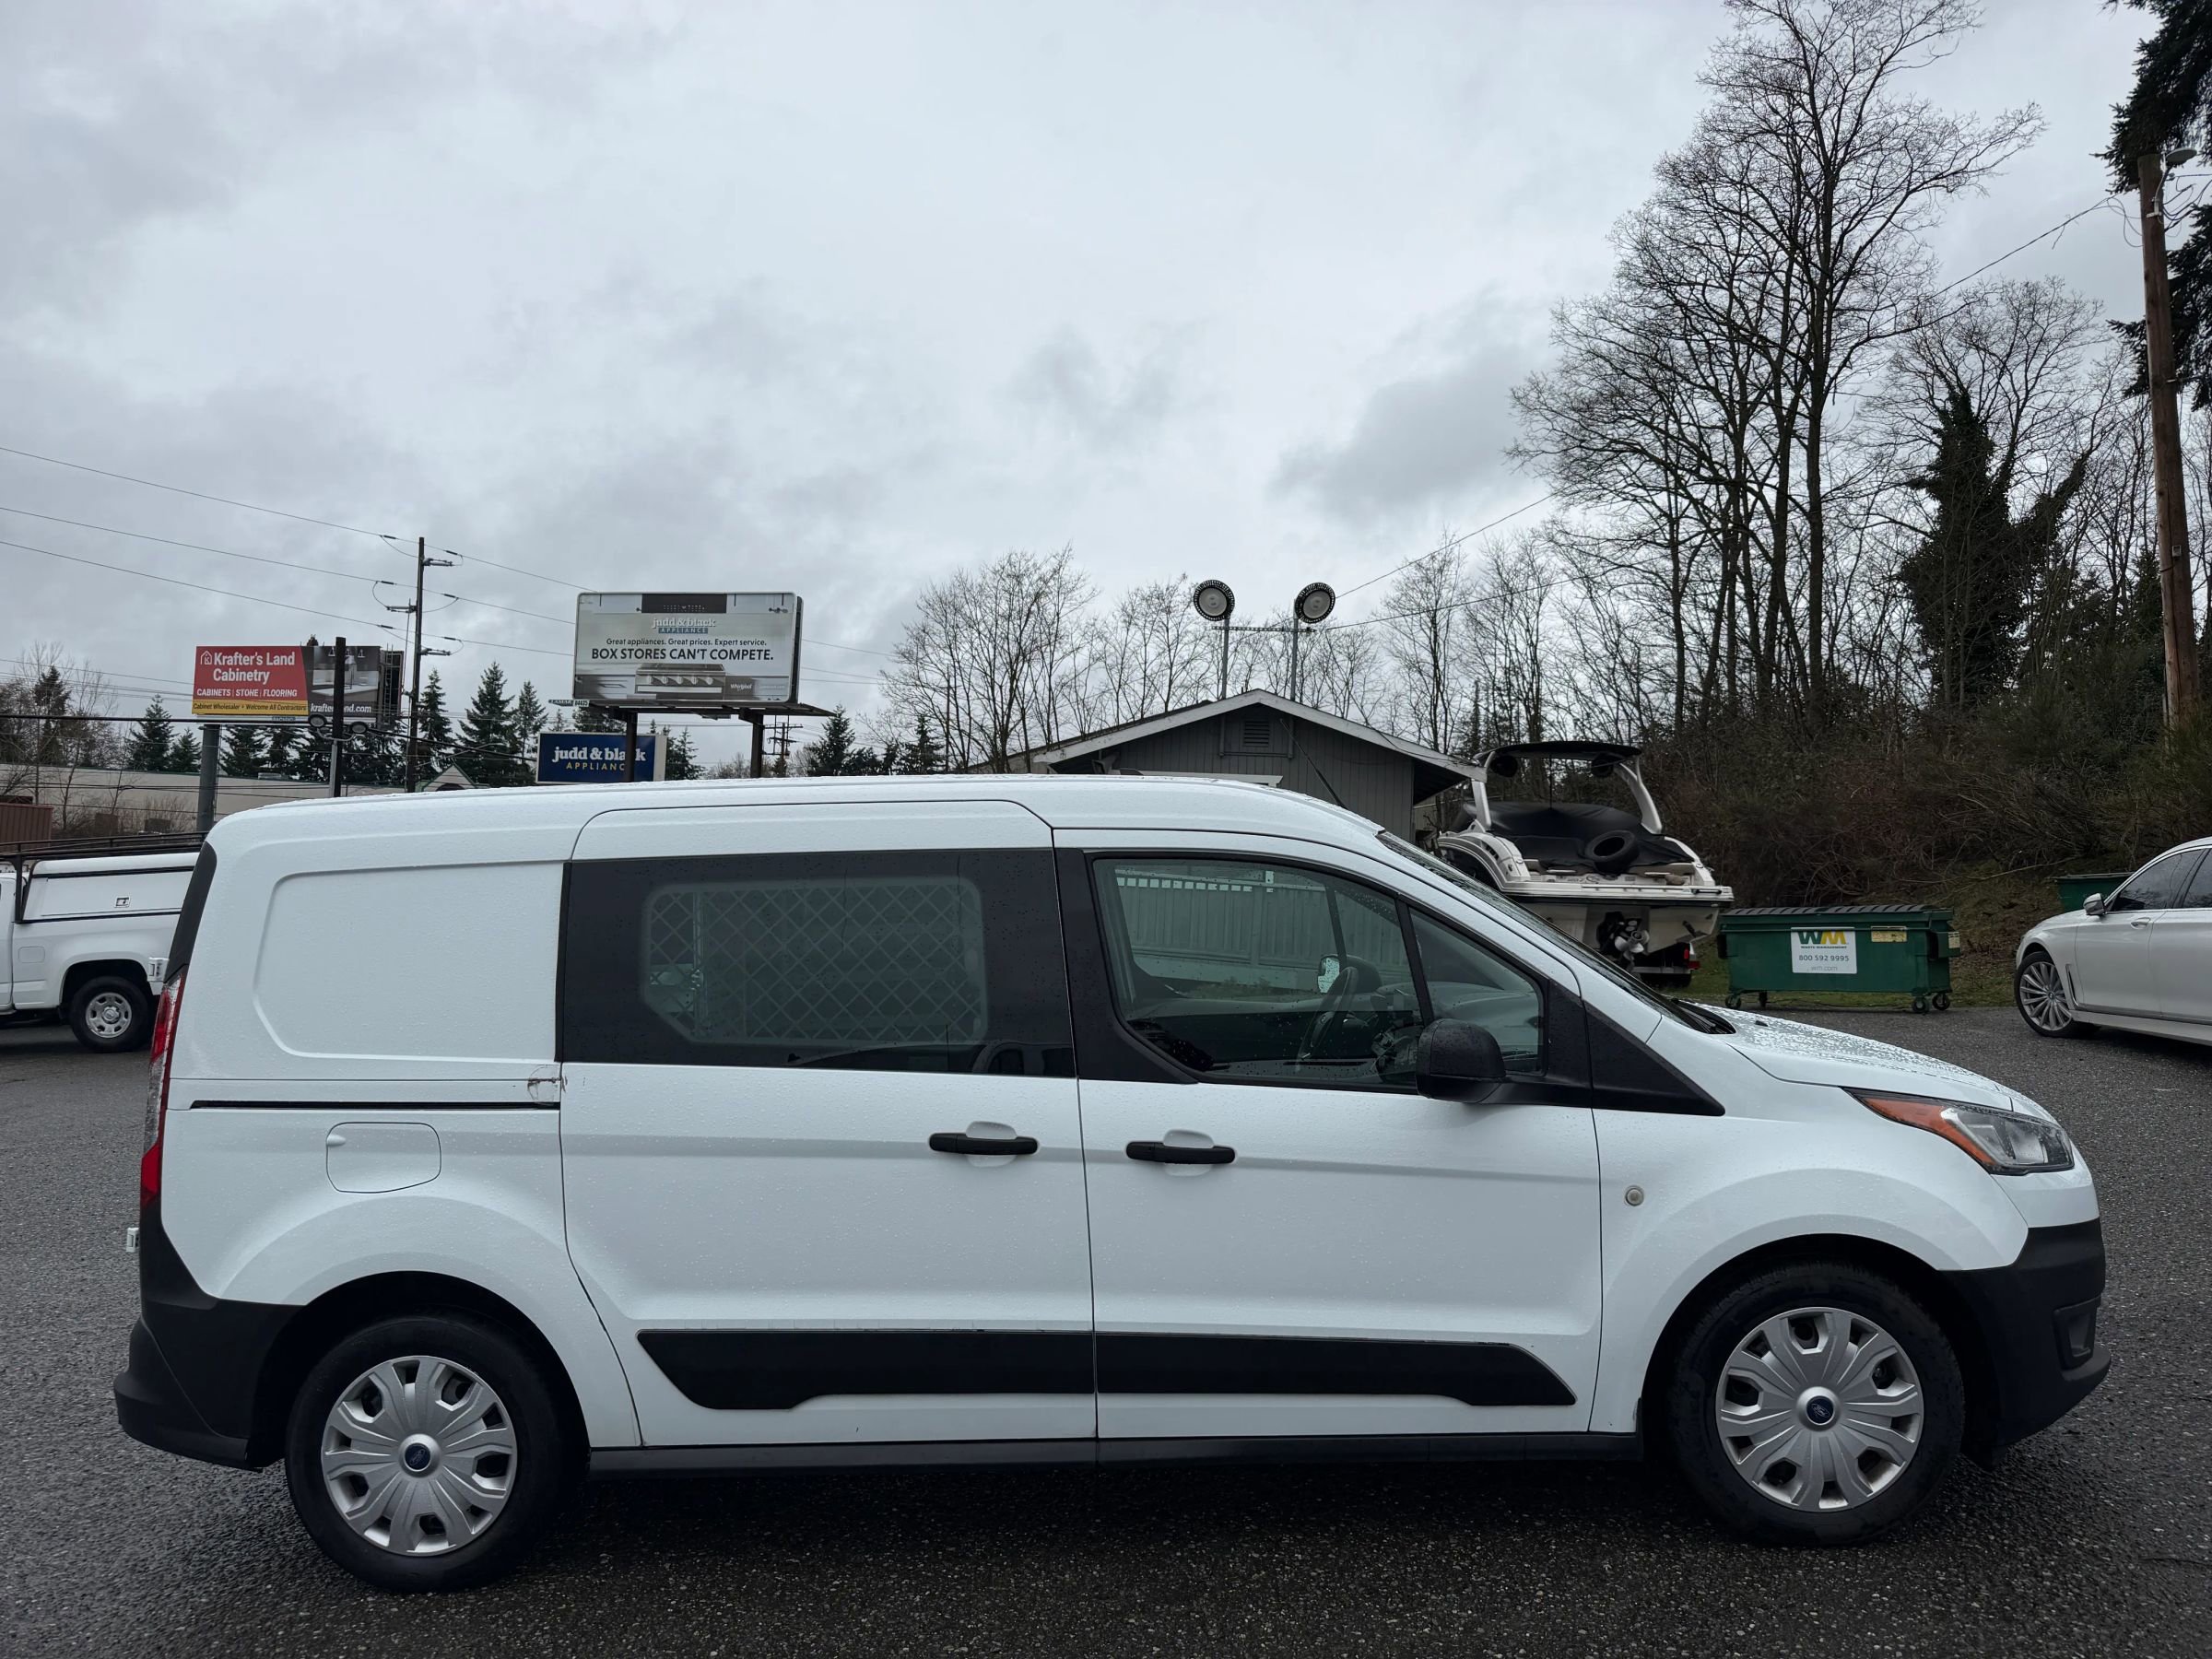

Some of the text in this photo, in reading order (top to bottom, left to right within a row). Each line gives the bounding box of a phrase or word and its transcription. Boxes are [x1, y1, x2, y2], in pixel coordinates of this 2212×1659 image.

[652, 618, 716, 629] judd & black
[627, 638, 666, 647] appliances.
[689, 638, 712, 647] prices.
[714, 639, 738, 647] Expert
[214, 651, 295, 665] Krafter's Land
[592, 648, 773, 661] BOX STORES CAN'T COMPETE.
[213, 667, 271, 685] Cabinetry
[196, 688, 298, 698] CABINETS STONE FLOORING
[552, 746, 646, 763] judd & blak
[566, 761, 627, 771] APPLIANC
[1796, 929, 1847, 945] WM
